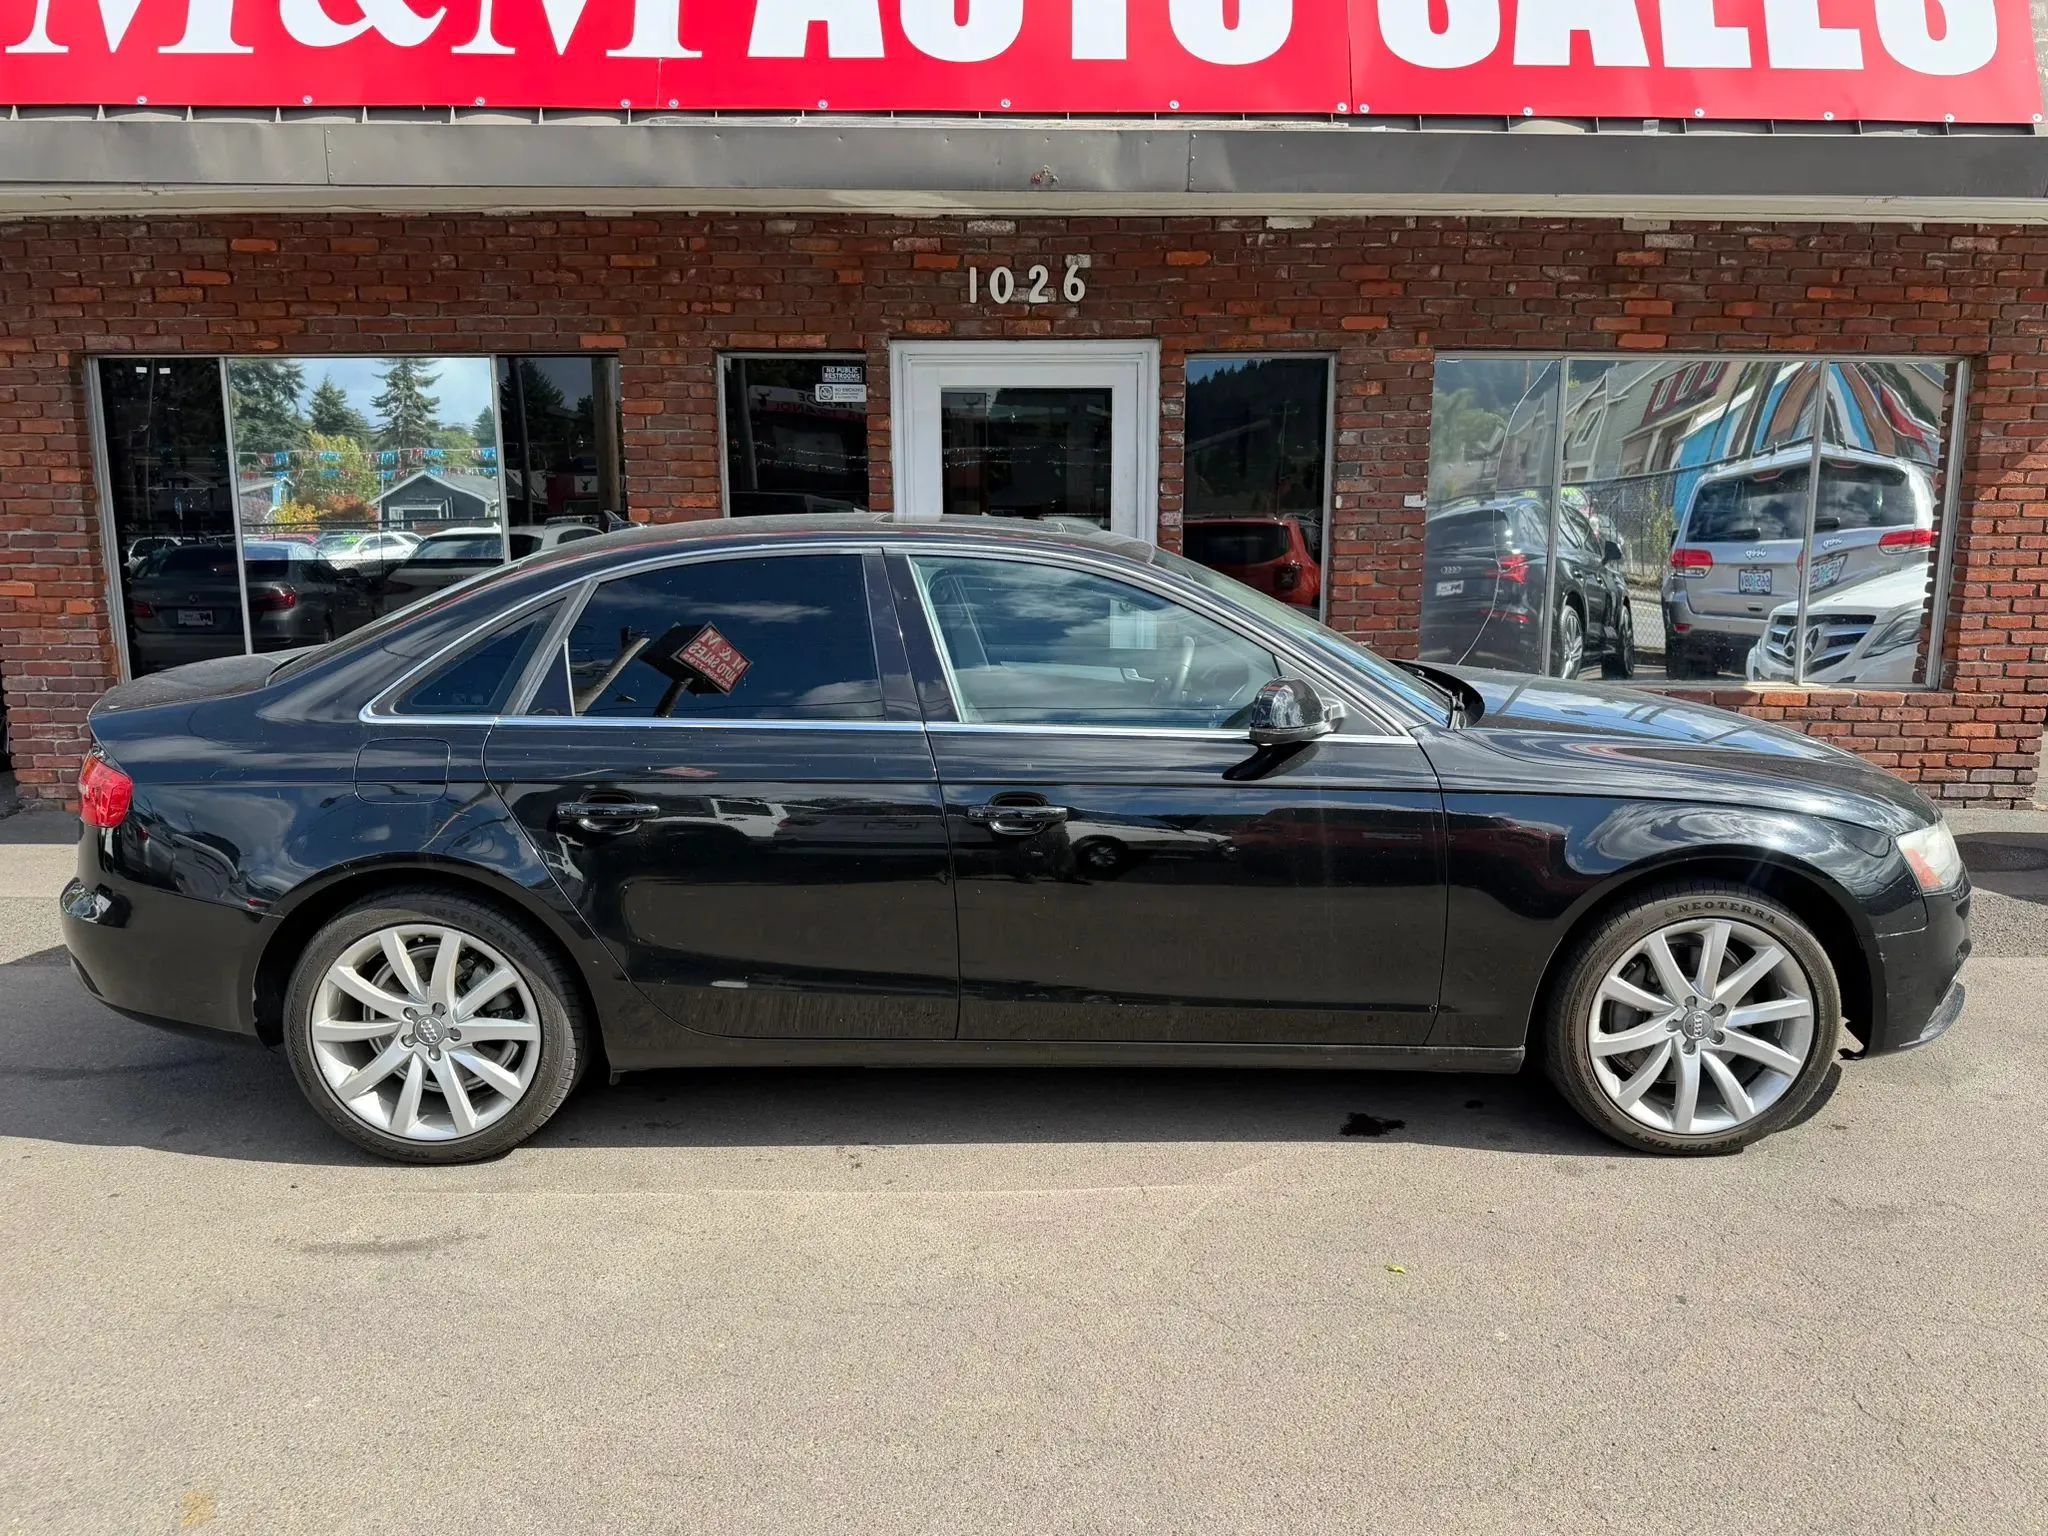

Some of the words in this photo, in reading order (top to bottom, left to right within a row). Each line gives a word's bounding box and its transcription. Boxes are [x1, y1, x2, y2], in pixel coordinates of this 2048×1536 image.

[969, 264, 1086, 304] 1026
[824, 372, 860, 380] RESTROOMS
[1678, 901, 1776, 924] NEOTERRA
